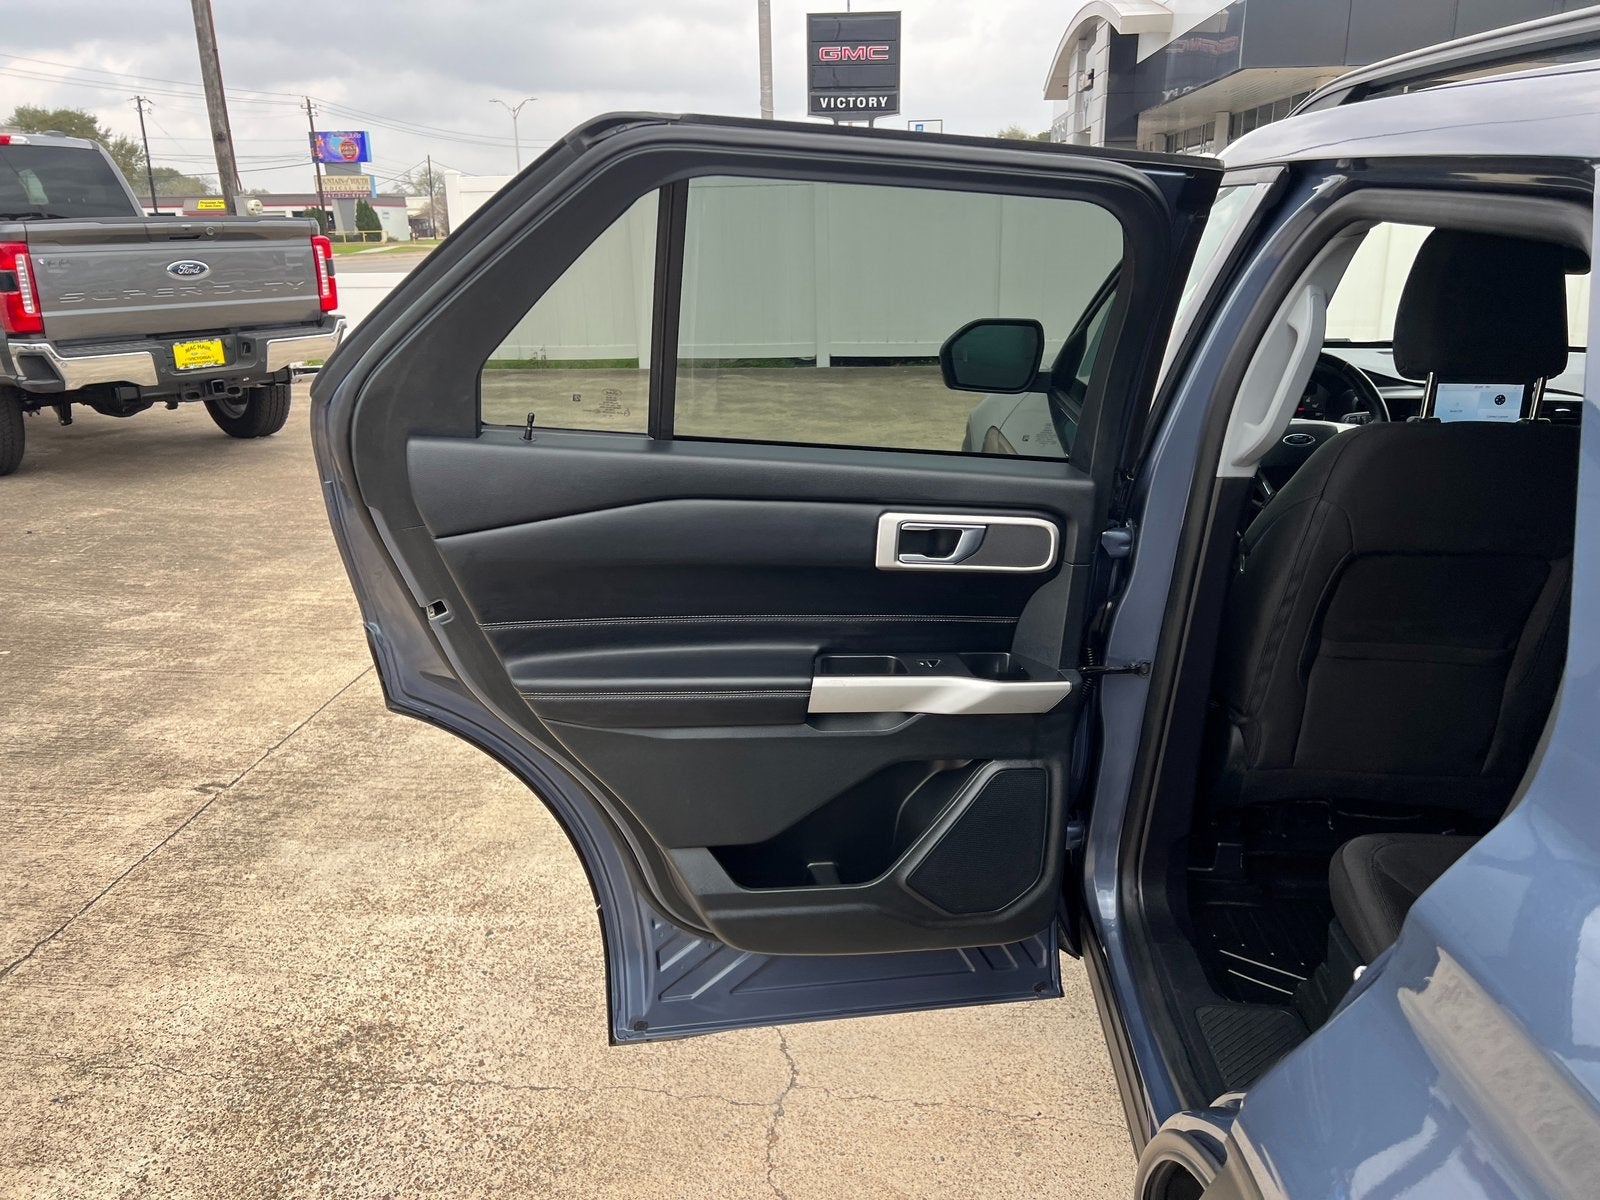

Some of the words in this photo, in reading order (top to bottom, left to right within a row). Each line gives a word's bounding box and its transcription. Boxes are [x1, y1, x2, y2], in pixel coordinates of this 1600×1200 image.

[819, 45, 889, 62] GMC
[820, 96, 888, 109] VICTORY
[177, 263, 200, 274] Ford
[59, 285, 203, 303] SUPER
[213, 280, 304, 294] DUTY
